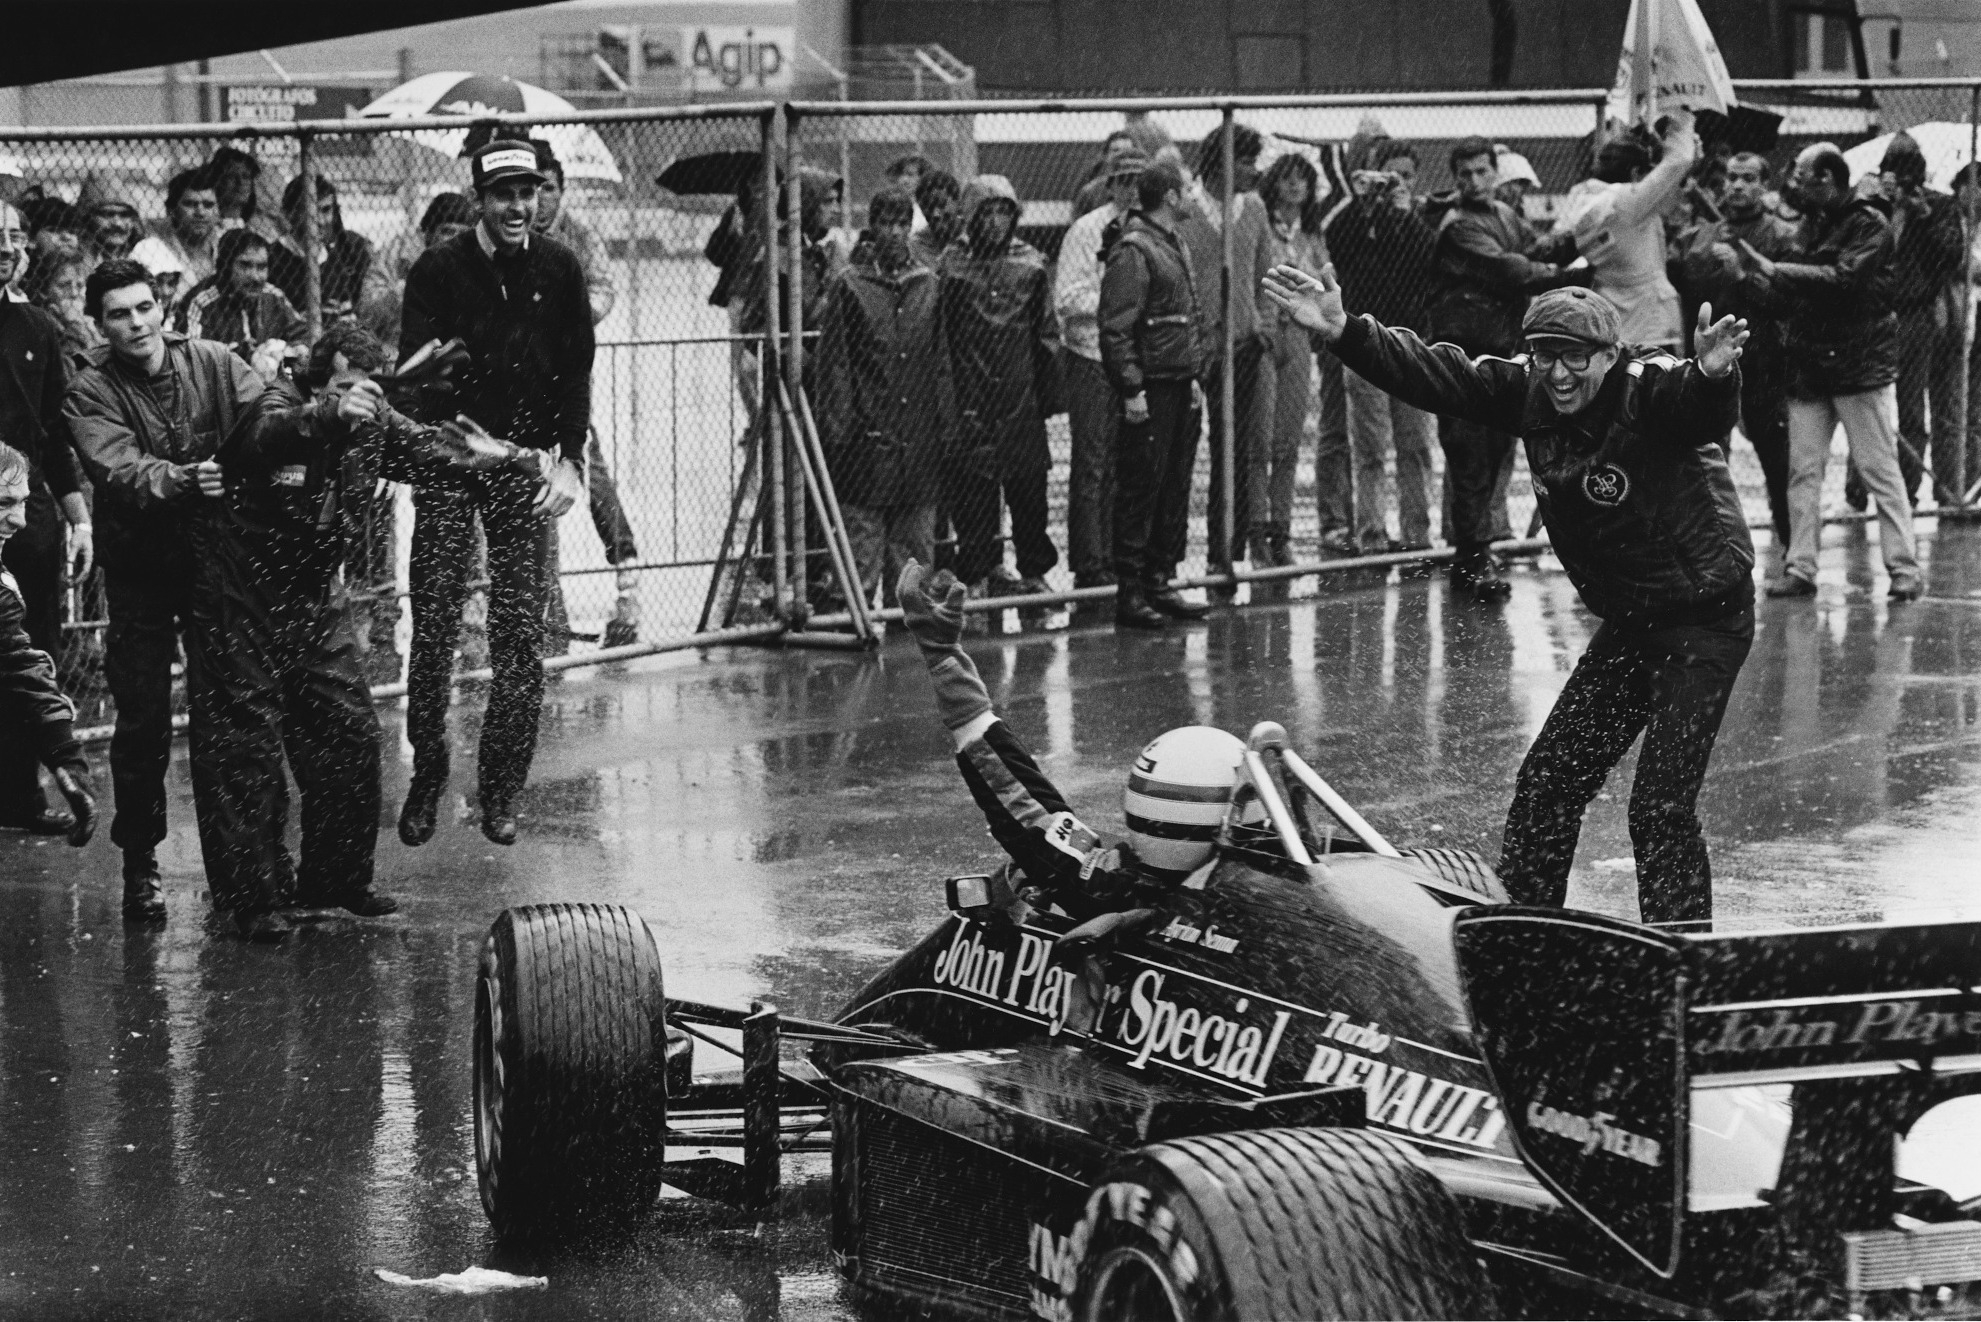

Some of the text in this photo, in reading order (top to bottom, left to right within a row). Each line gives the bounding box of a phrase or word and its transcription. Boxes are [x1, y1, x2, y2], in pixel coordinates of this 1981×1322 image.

[692, 30, 783, 88] Agip
[933, 916, 1291, 1088] John Playr Special
[1321, 1010, 1391, 1053] Turbo
[1692, 1008, 1839, 1055] John
[1303, 1043, 1506, 1149] RENAULT
